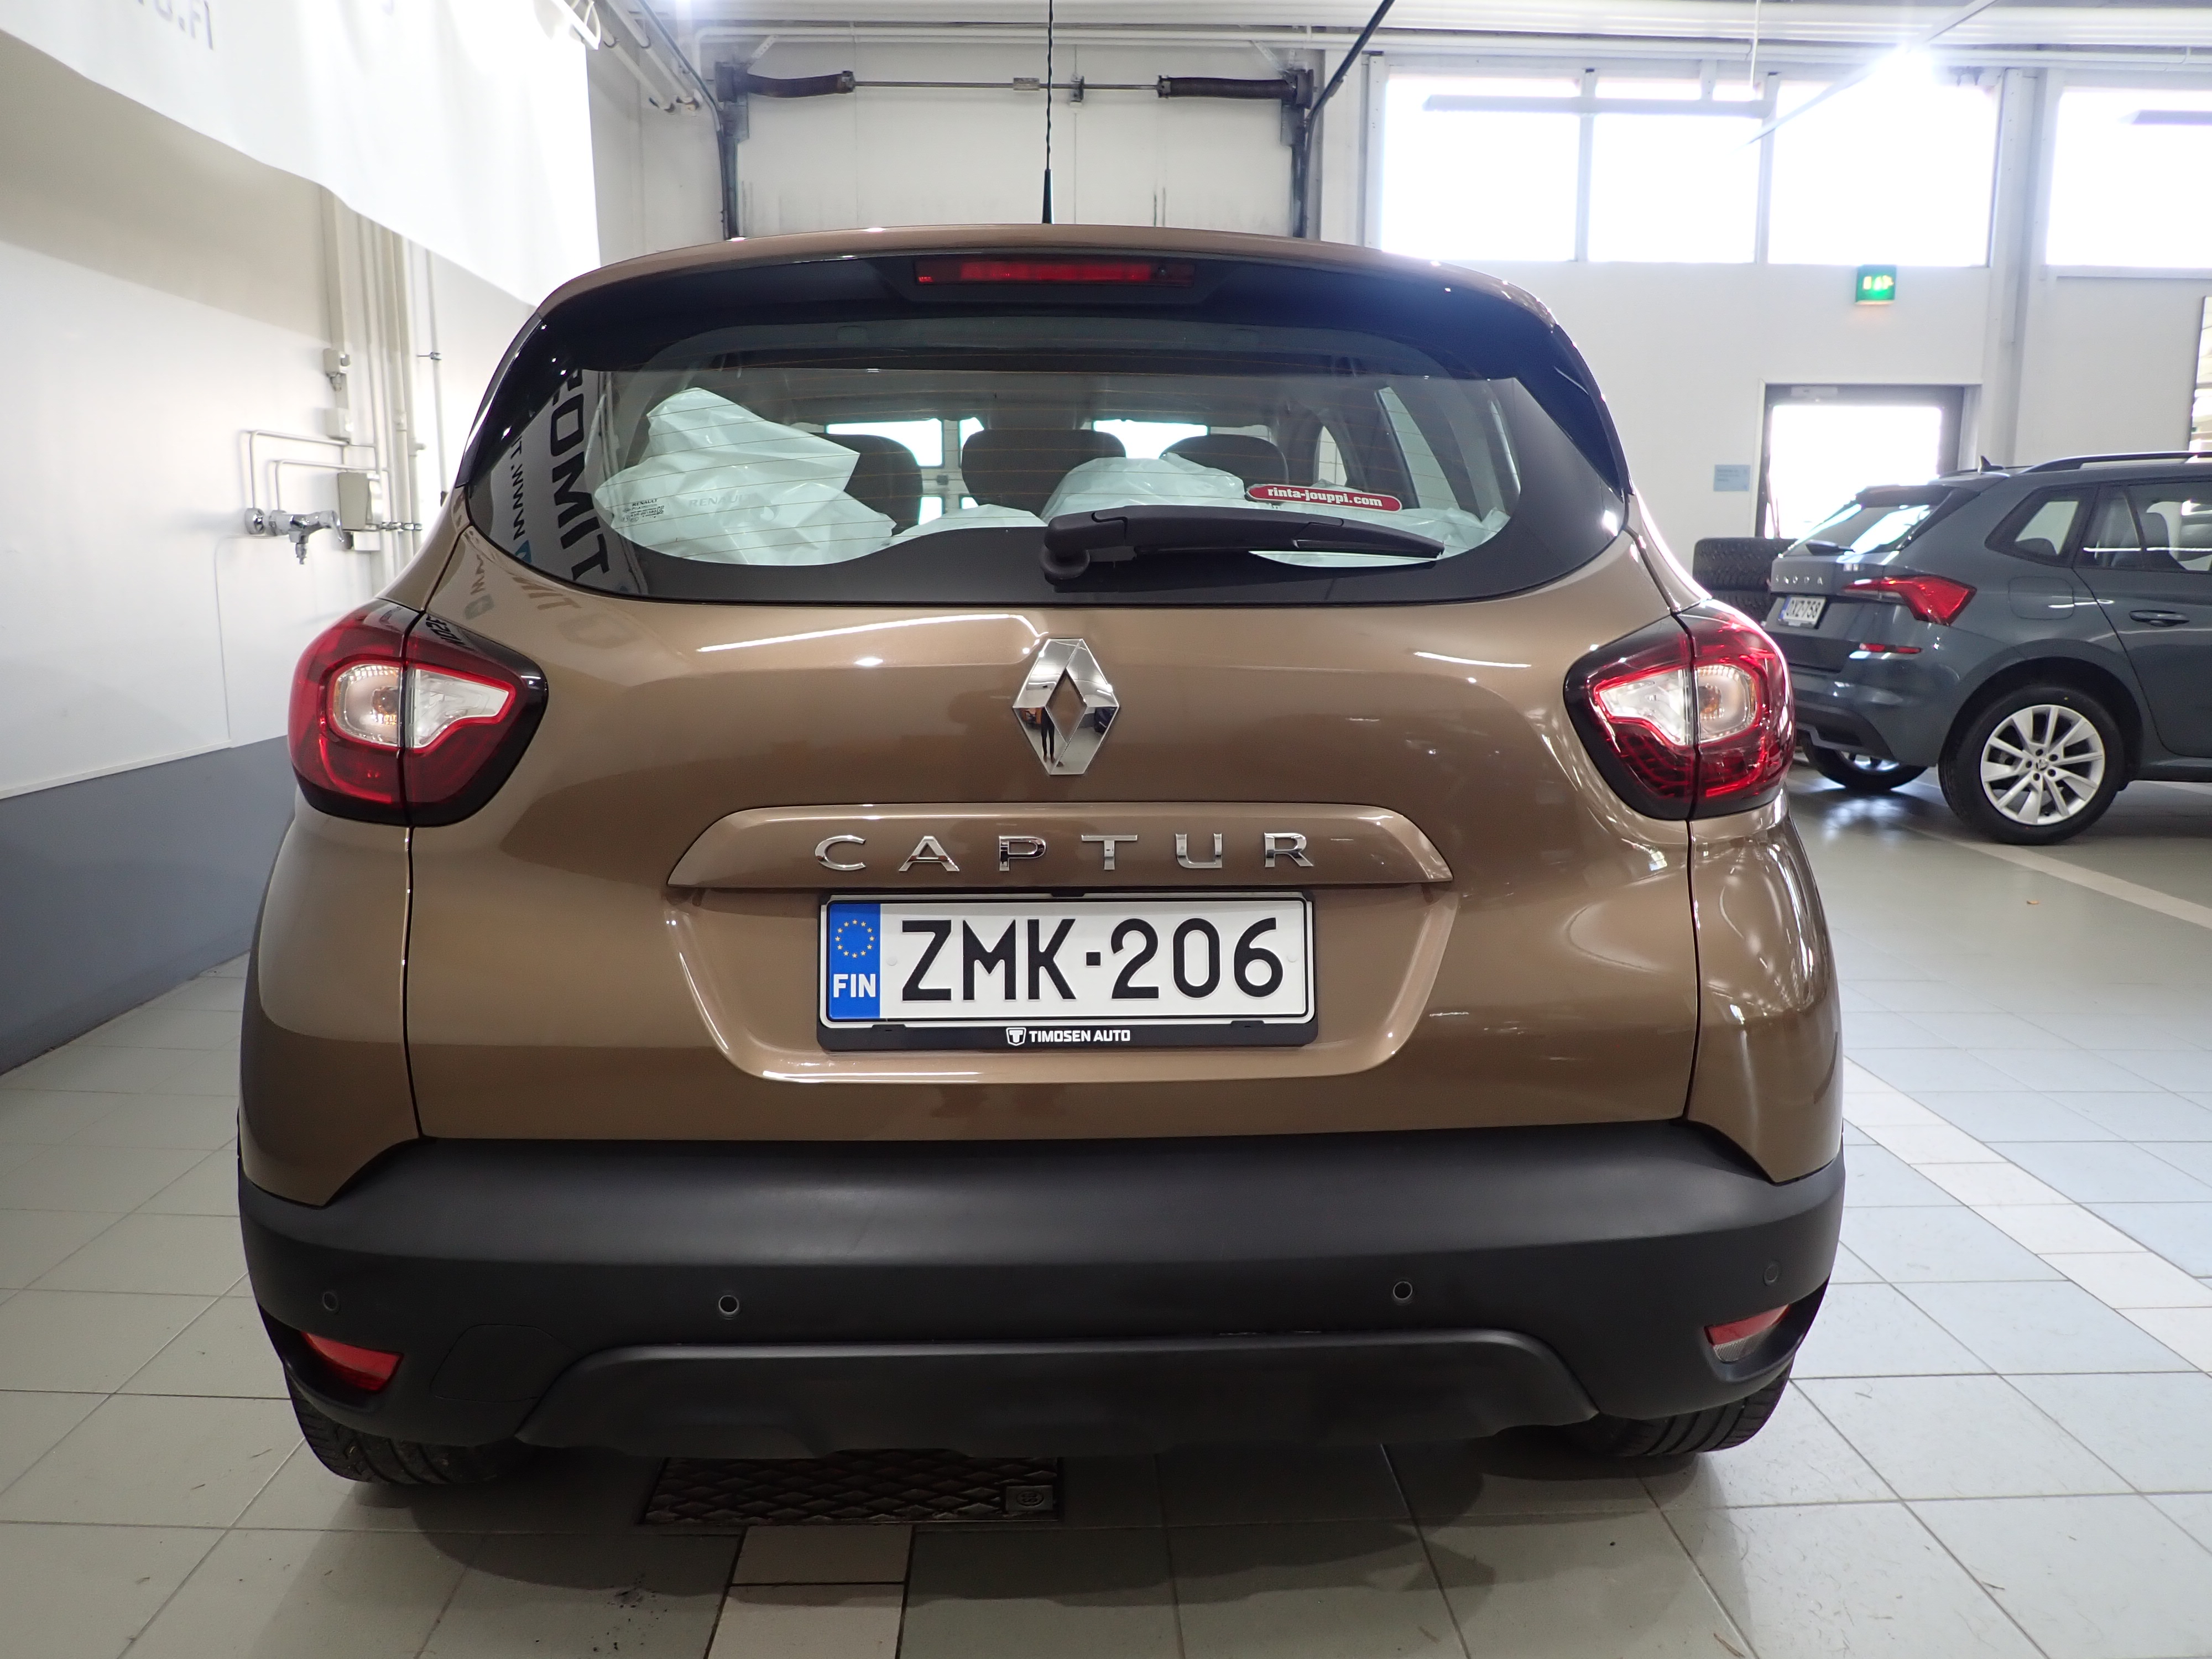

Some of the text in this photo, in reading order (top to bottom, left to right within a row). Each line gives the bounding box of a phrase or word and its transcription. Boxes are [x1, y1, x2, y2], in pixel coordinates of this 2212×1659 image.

[1267, 487, 1383, 507] rinta-jouppi.com
[814, 832, 1314, 872] CAPTUR
[901, 916, 1284, 1001] ZMK-206
[832, 973, 877, 999] FIN
[1029, 1030, 1092, 1042] TIMOSEN
[1093, 1029, 1130, 1041] AUTO
